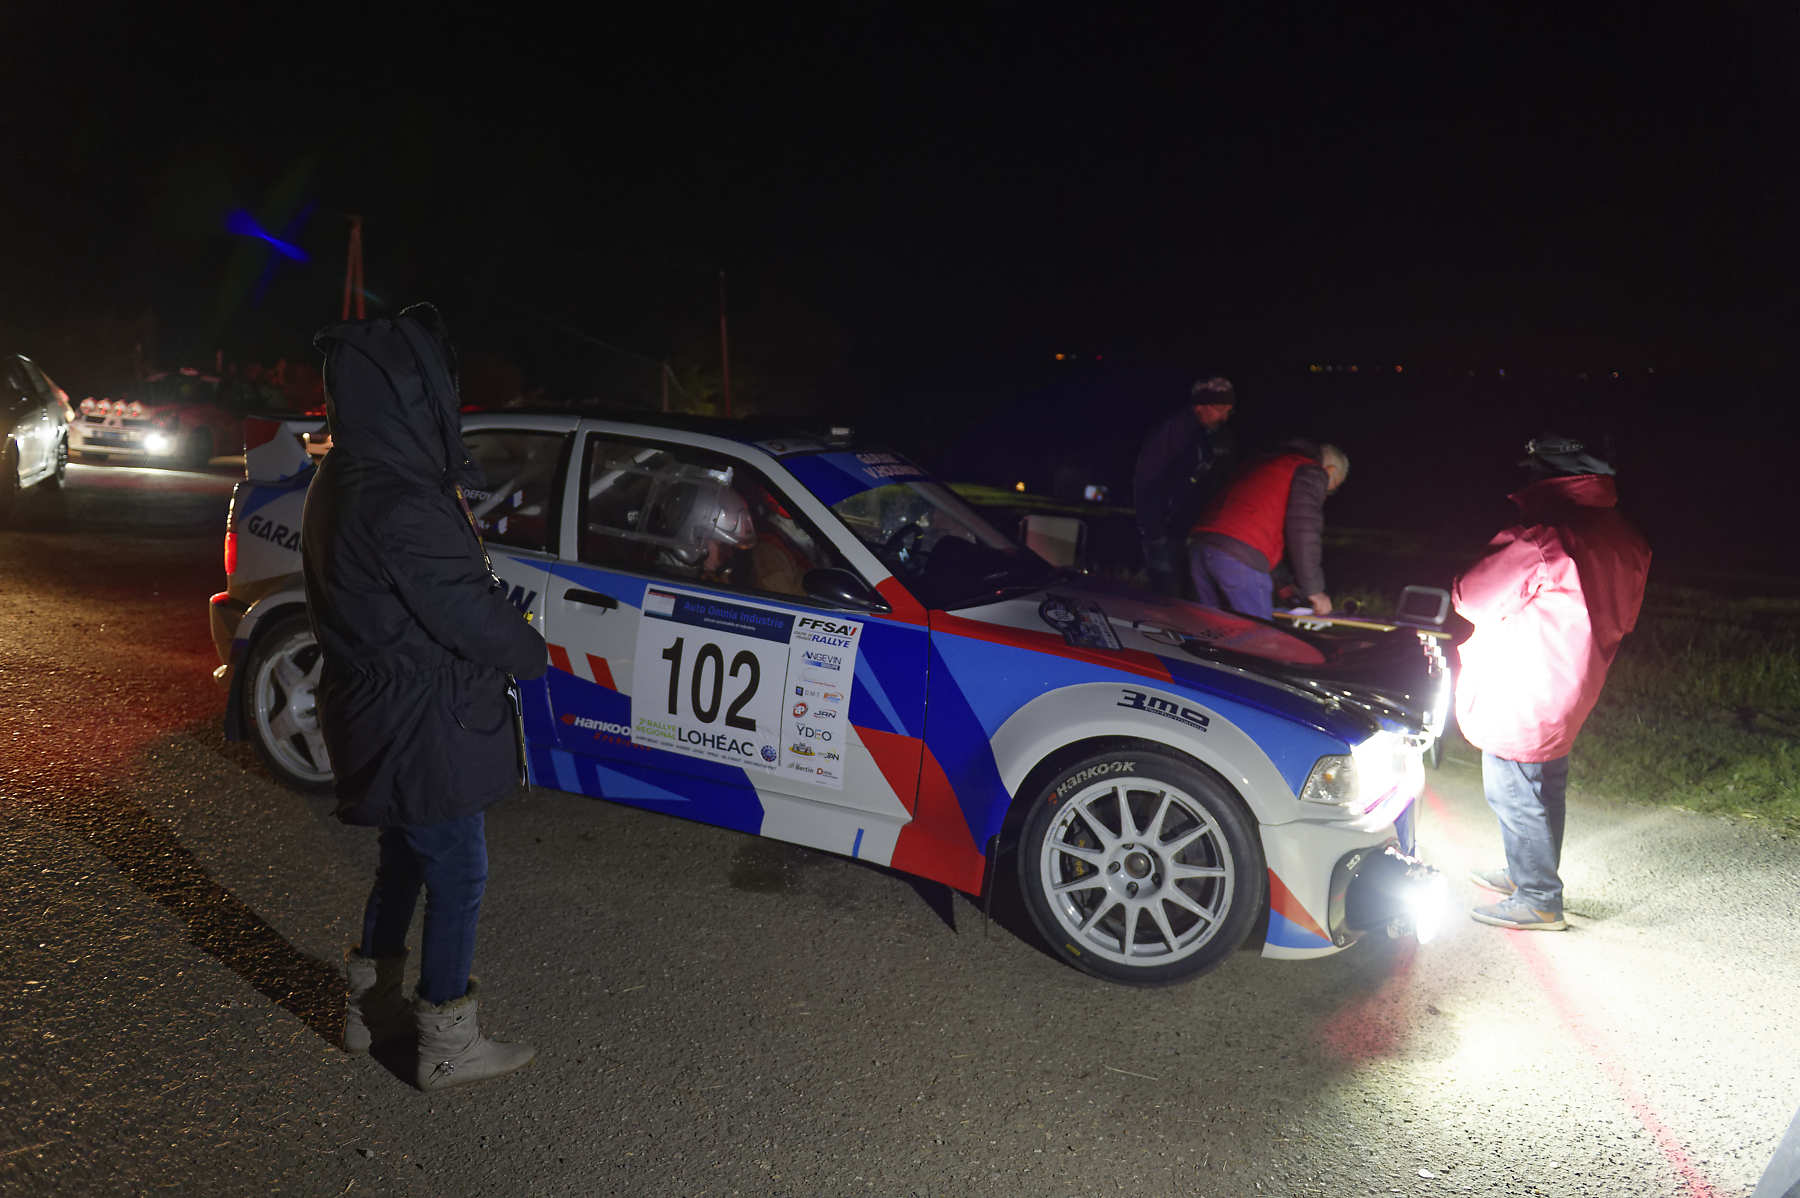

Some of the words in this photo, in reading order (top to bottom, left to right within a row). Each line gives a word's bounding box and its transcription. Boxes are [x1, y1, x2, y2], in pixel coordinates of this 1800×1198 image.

[248, 515, 300, 552] GARA
[798, 617, 849, 636] FFSA
[811, 633, 851, 648] RALLYE
[662, 637, 760, 732] 102
[678, 727, 754, 757] LOHÉAC
